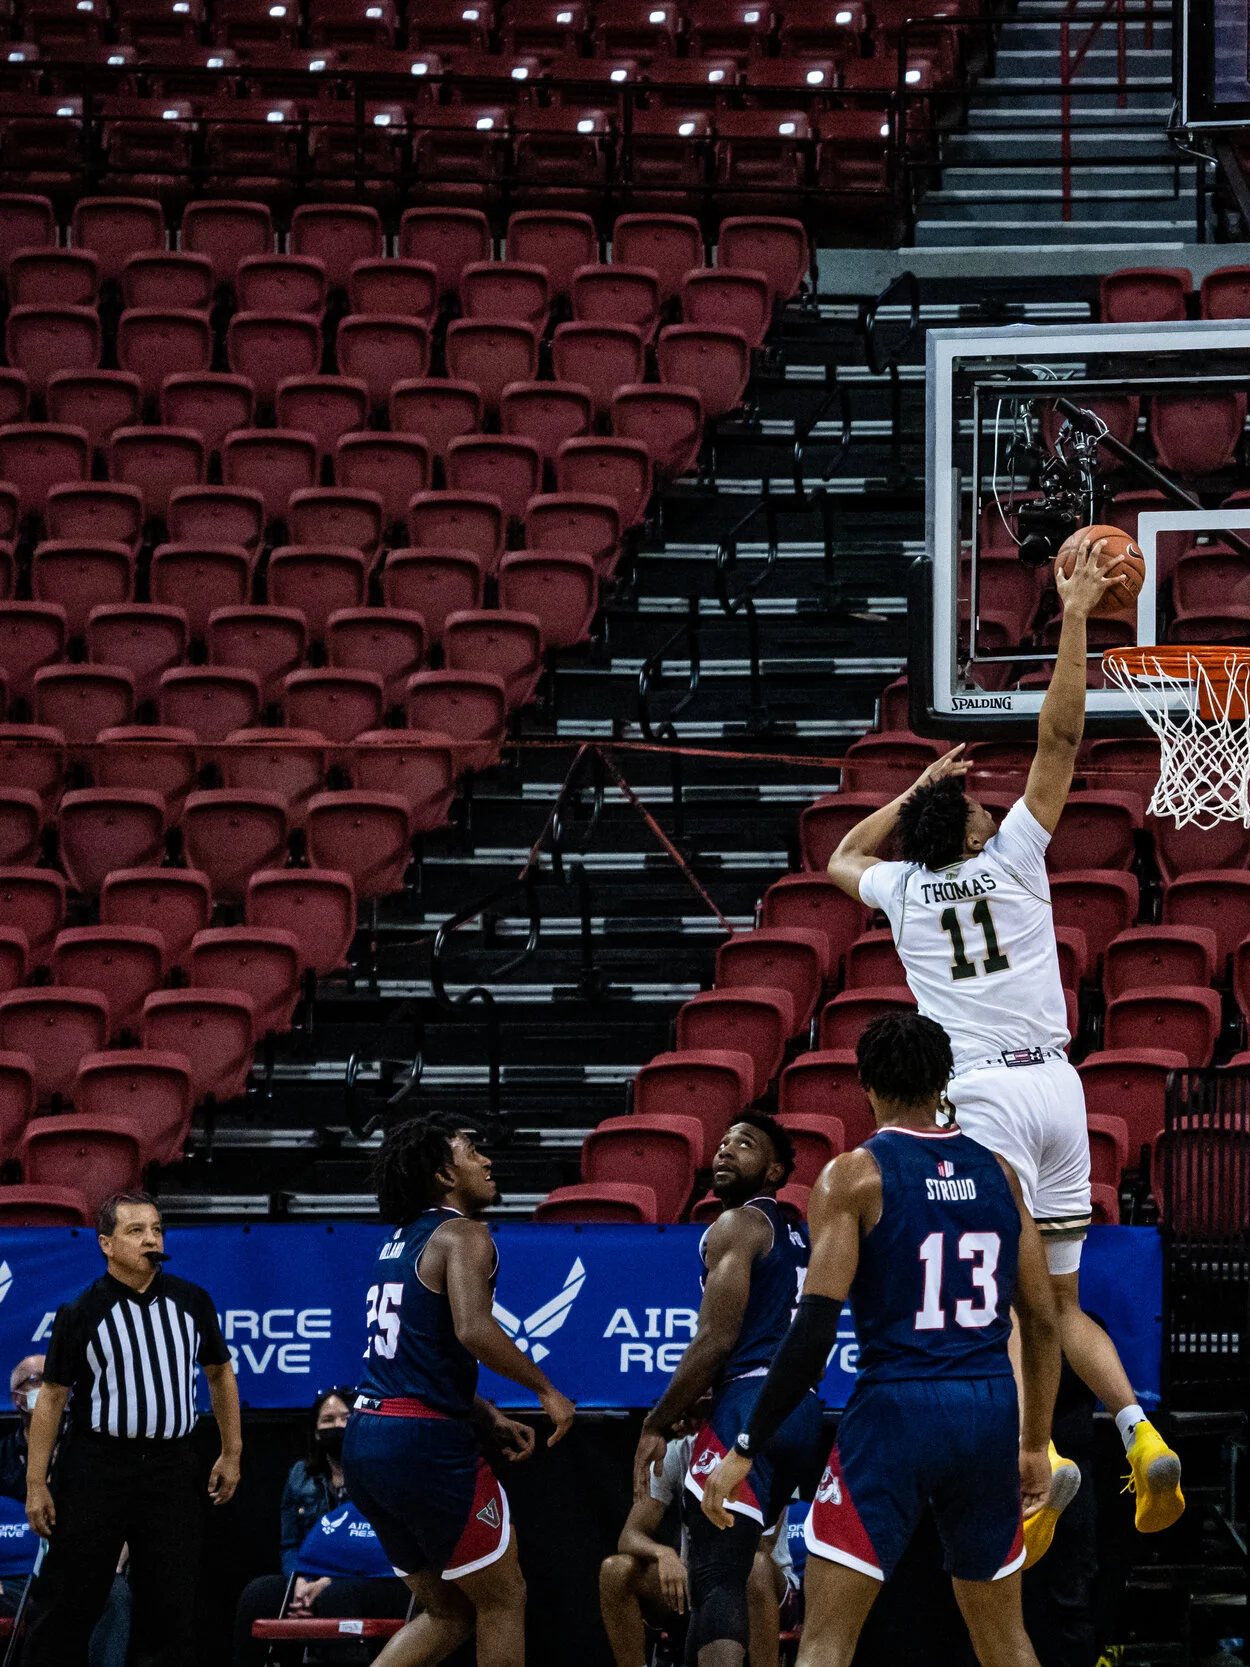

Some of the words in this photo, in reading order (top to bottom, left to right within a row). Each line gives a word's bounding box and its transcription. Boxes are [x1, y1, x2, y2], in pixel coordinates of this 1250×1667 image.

[951, 696, 1012, 711] SPALDING
[921, 873, 996, 904] THOMAS
[940, 897, 1011, 982] 11
[925, 1178, 977, 1201] STROUD
[914, 1231, 1001, 1330] 13
[362, 1282, 405, 1360] 25
[602, 1308, 699, 1338] AIR
[348, 1522, 371, 1530] AIR
